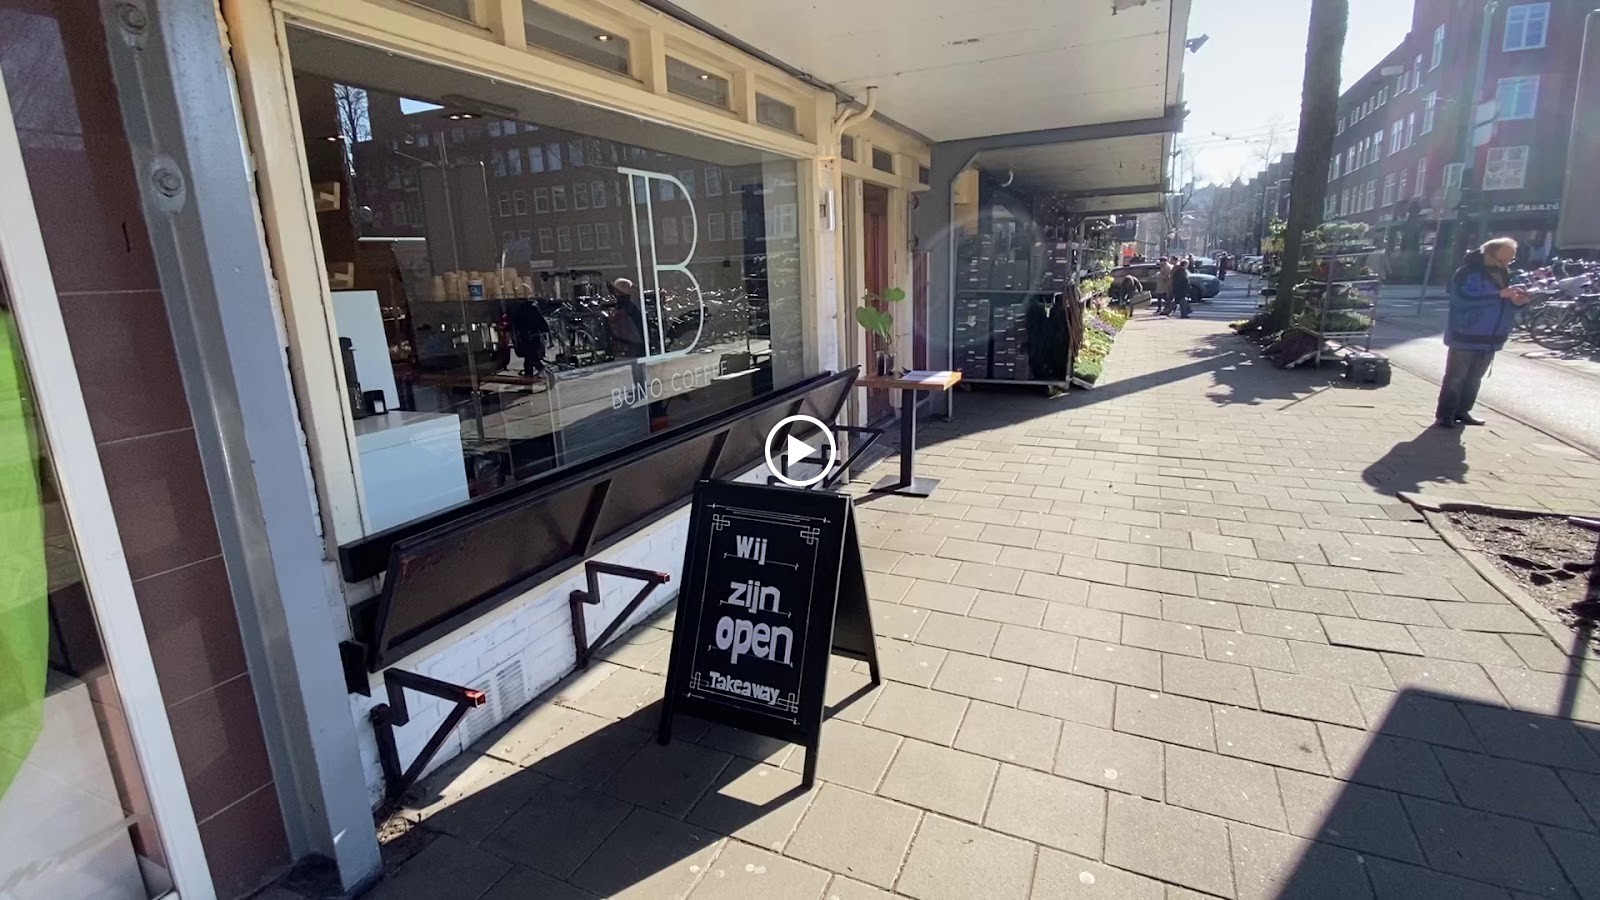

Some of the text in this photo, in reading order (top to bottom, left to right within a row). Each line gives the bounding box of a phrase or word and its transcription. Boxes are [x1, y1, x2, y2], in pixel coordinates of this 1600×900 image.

[611, 360, 728, 410] BUNO COFFEE
[728, 580, 780, 613] zijn
[715, 616, 794, 664] open
[709, 671, 780, 705] Takeaway
